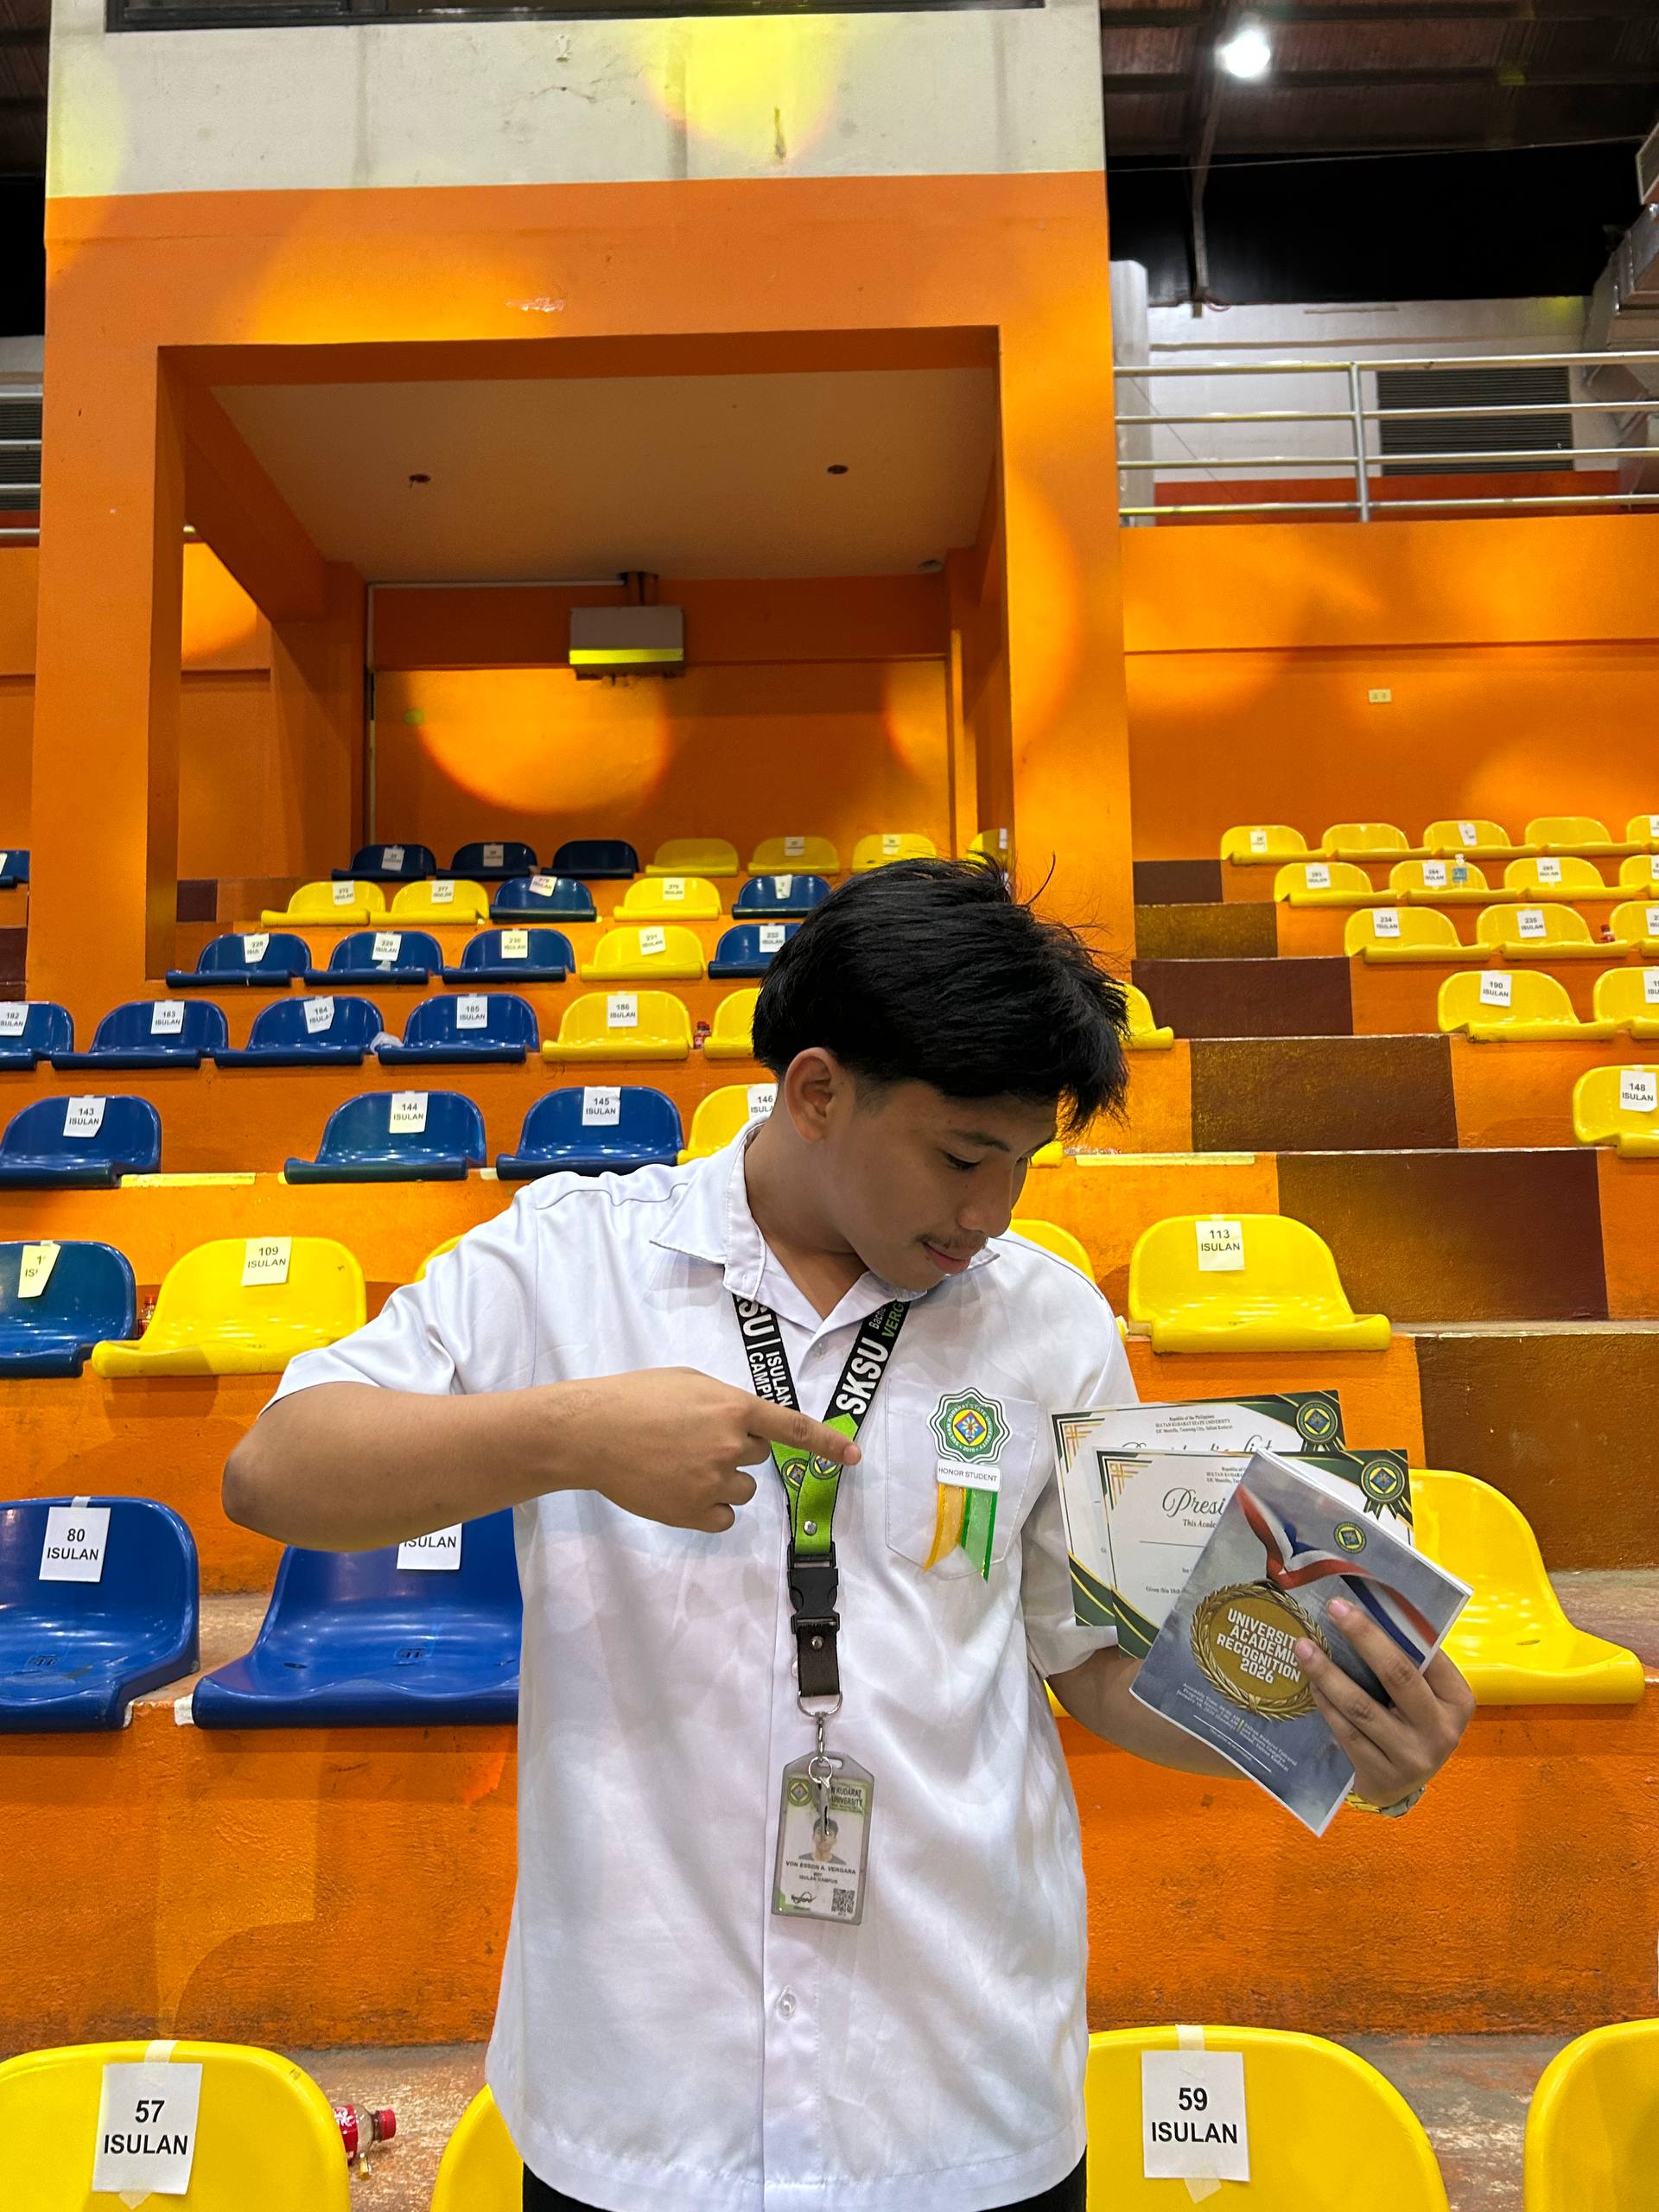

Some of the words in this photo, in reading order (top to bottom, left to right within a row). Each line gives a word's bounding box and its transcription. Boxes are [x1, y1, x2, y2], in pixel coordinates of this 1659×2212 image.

[1483, 988, 1509, 997] ISULAN
[1630, 1083, 1646, 1091] 148
[1622, 1092, 1654, 1102] ISULAN
[1209, 1229, 1230, 1239] 113
[259, 1246, 279, 1256] 109
[1201, 1243, 1240, 1251] ISULAN
[248, 1258, 287, 1268] ISULAN
[766, 1351, 793, 1407] ISULAN
[836, 1337, 888, 1415] SKSU
[938, 1467, 964, 1477] HONOR
[965, 1471, 997, 1482] STUDENT
[1162, 1487, 1226, 1517] Presi
[1182, 1518, 1197, 1528] This
[1198, 1520, 1217, 1529] Acade
[67, 1528, 86, 1542] 80
[47, 1548, 99, 1560] ISULAN
[1227, 1608, 1298, 1649] UNIVERSIT
[1217, 1633, 1301, 1682] RECOGNITION
[1240, 1657, 1274, 1684] 2026
[1178, 2088, 1208, 2111] 59
[134, 2100, 165, 2123] 57
[1151, 2121, 1237, 2144] ISULAN
[104, 2133, 188, 2155] ISULAN
